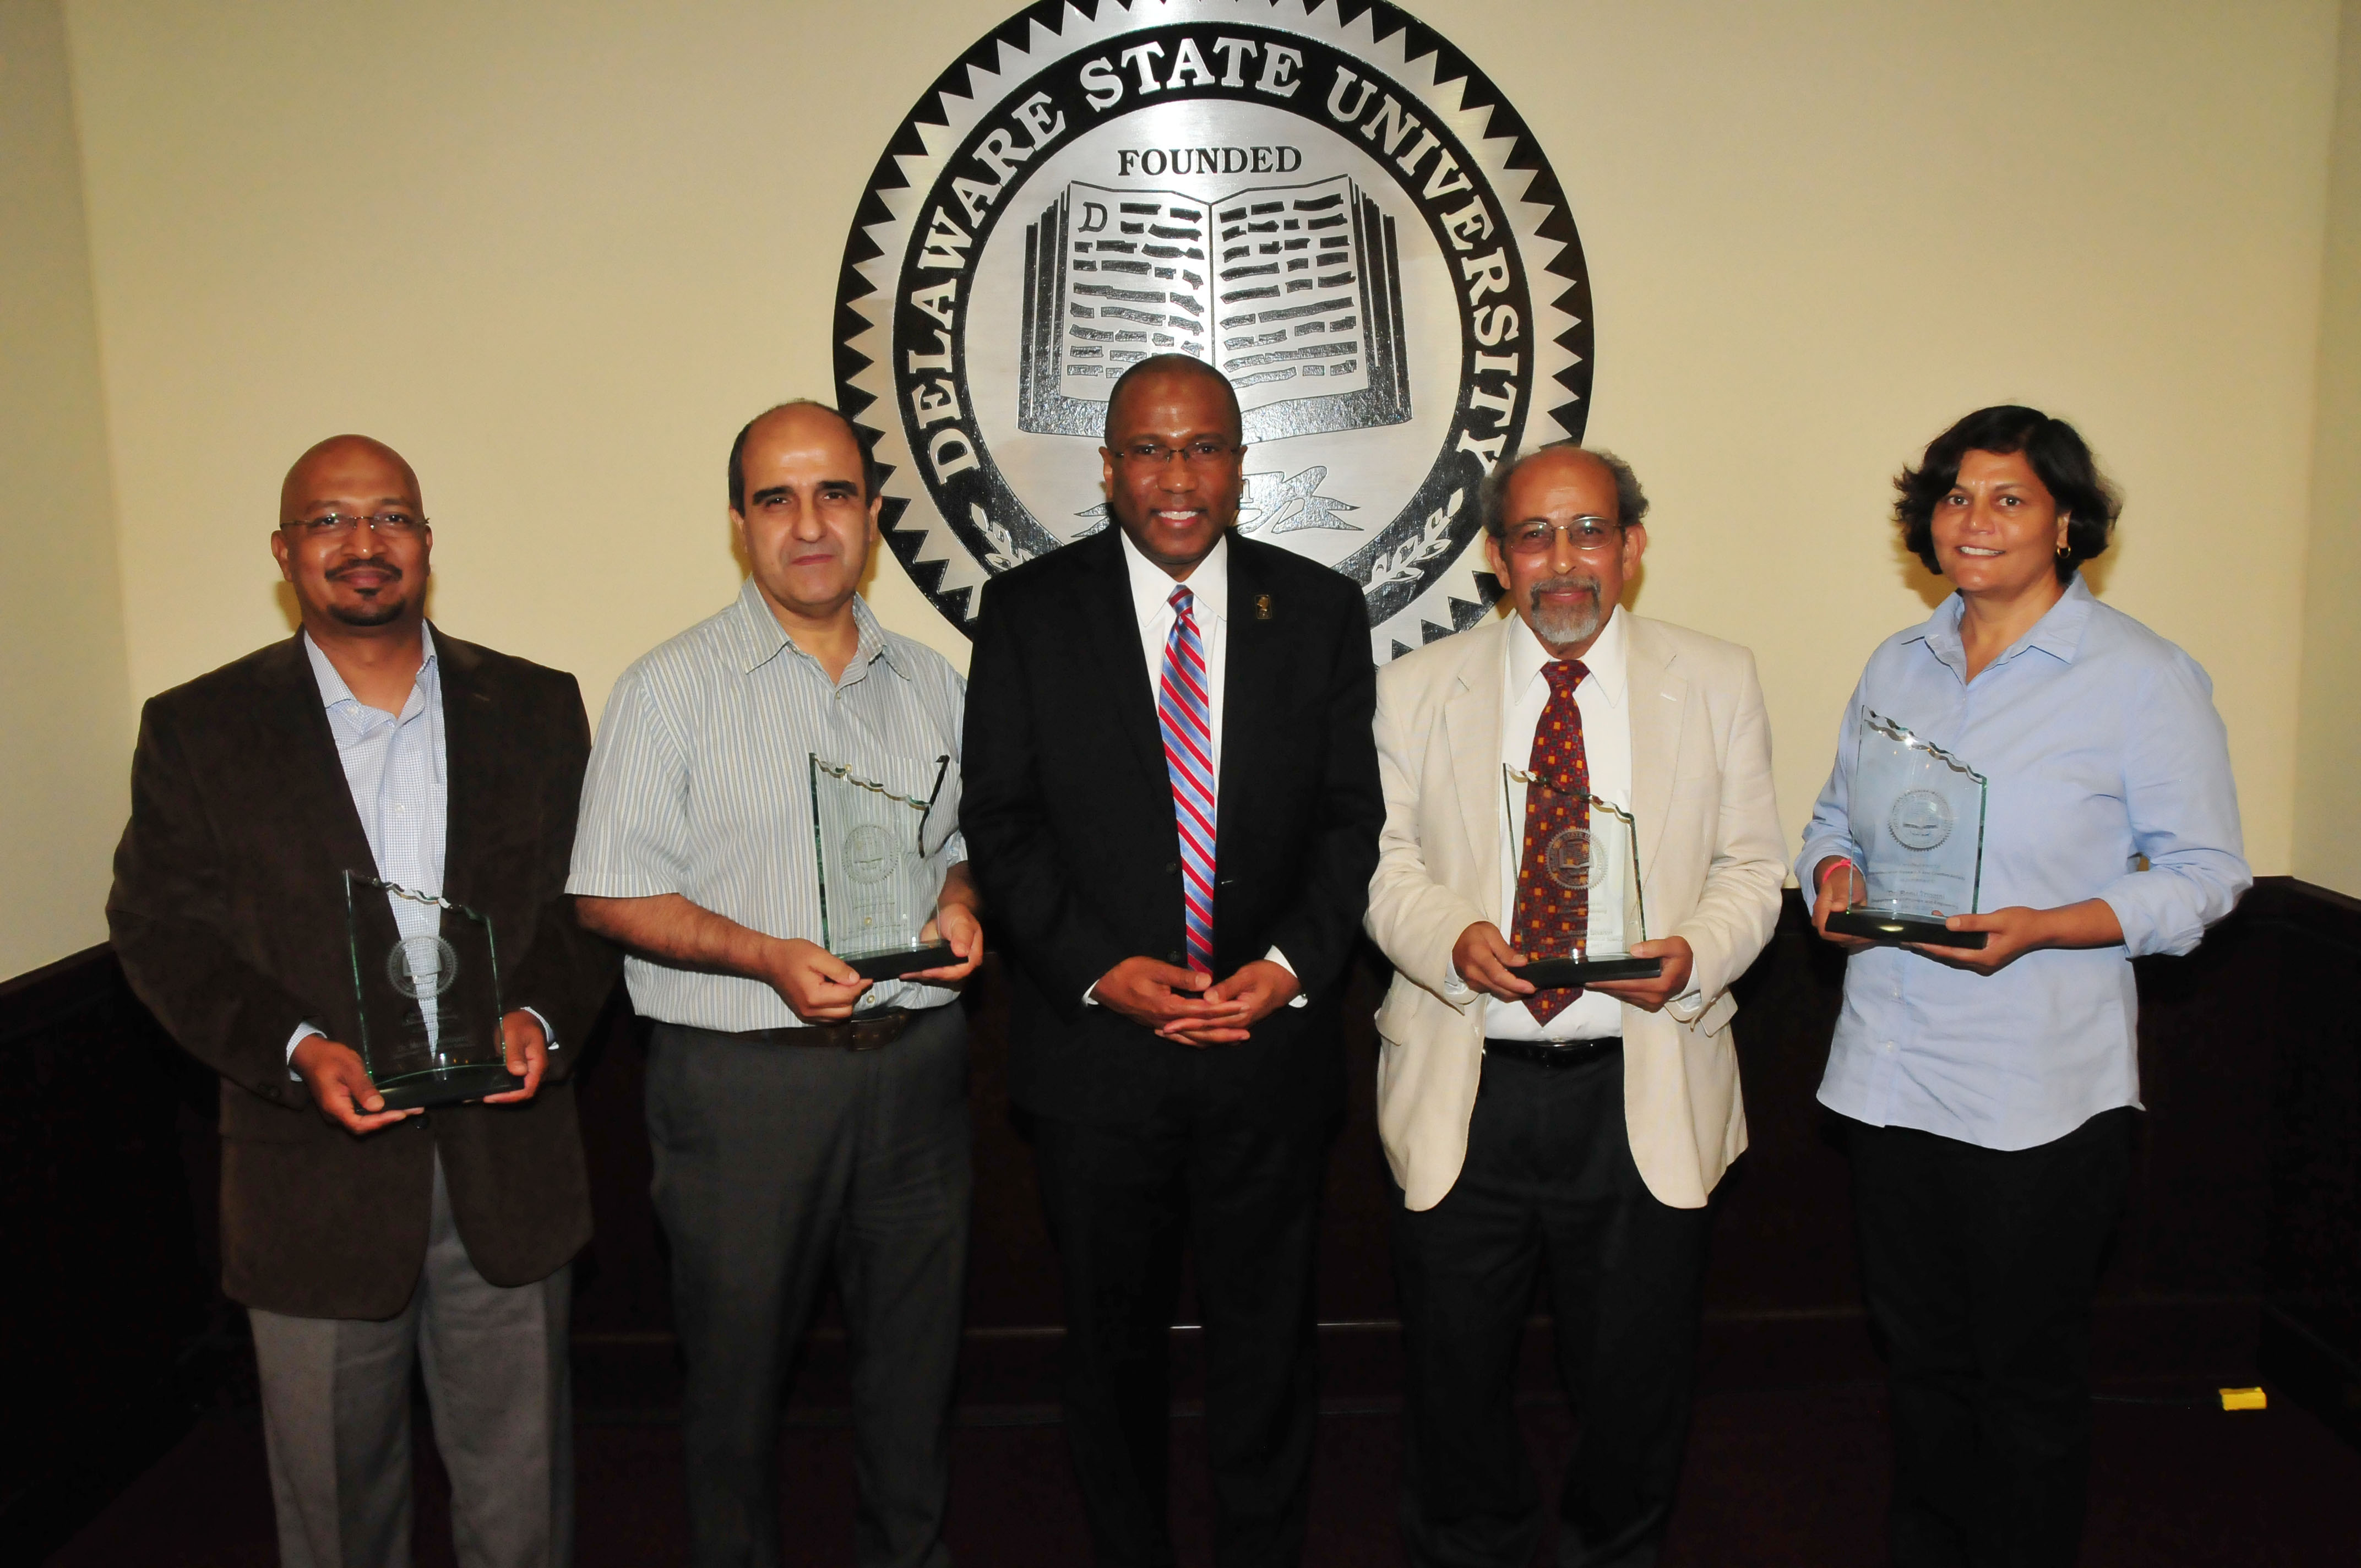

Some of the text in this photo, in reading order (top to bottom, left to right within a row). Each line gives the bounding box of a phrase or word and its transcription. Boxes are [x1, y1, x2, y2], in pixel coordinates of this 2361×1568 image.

[907, 37, 1519, 484] DELAWARE STATE UNIVERSITY
[1117, 146, 1302, 176] FOUNDED
